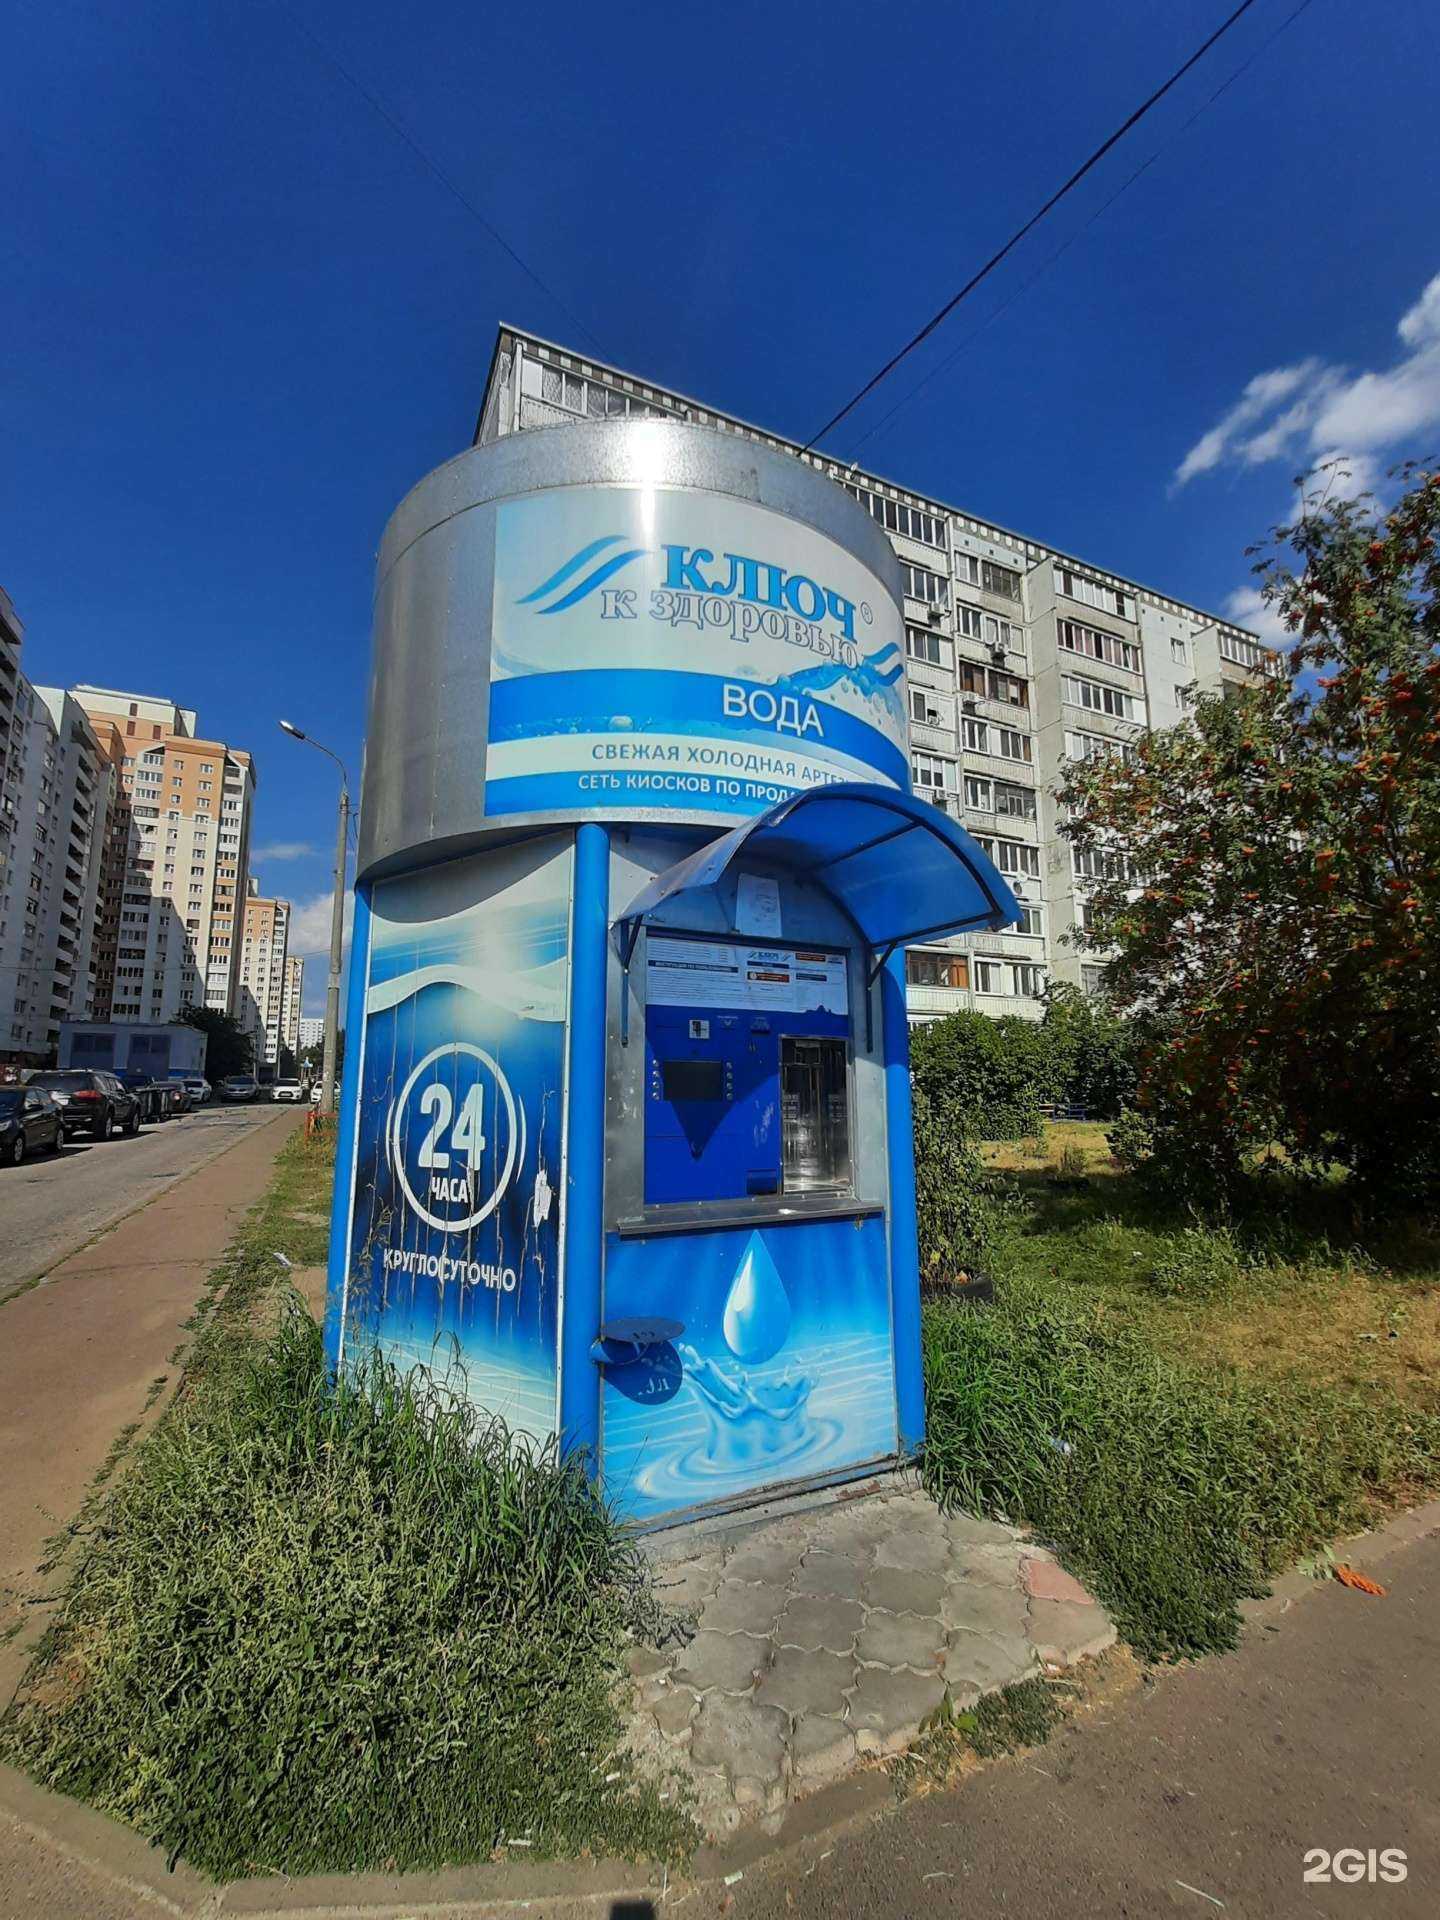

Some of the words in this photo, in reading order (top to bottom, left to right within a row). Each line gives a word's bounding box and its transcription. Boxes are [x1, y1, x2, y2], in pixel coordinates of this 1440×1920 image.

[660, 544, 858, 644] КЛЮЧ
[722, 683, 824, 737] ВОДА
[591, 743, 680, 762] СВЕЖАЯ
[687, 746, 796, 777] ХОЛОДНАЯ
[578, 773, 621, 790] СЕТЬ
[626, 774, 711, 793] КИОСКОВ
[715, 779, 741, 796] ПО
[745, 783, 796, 803] ПРОД
[417, 1082, 486, 1171] 24
[431, 1176, 469, 1204] ЧАСА
[383, 1247, 517, 1292] КРУГЛОСУТОЧНО
